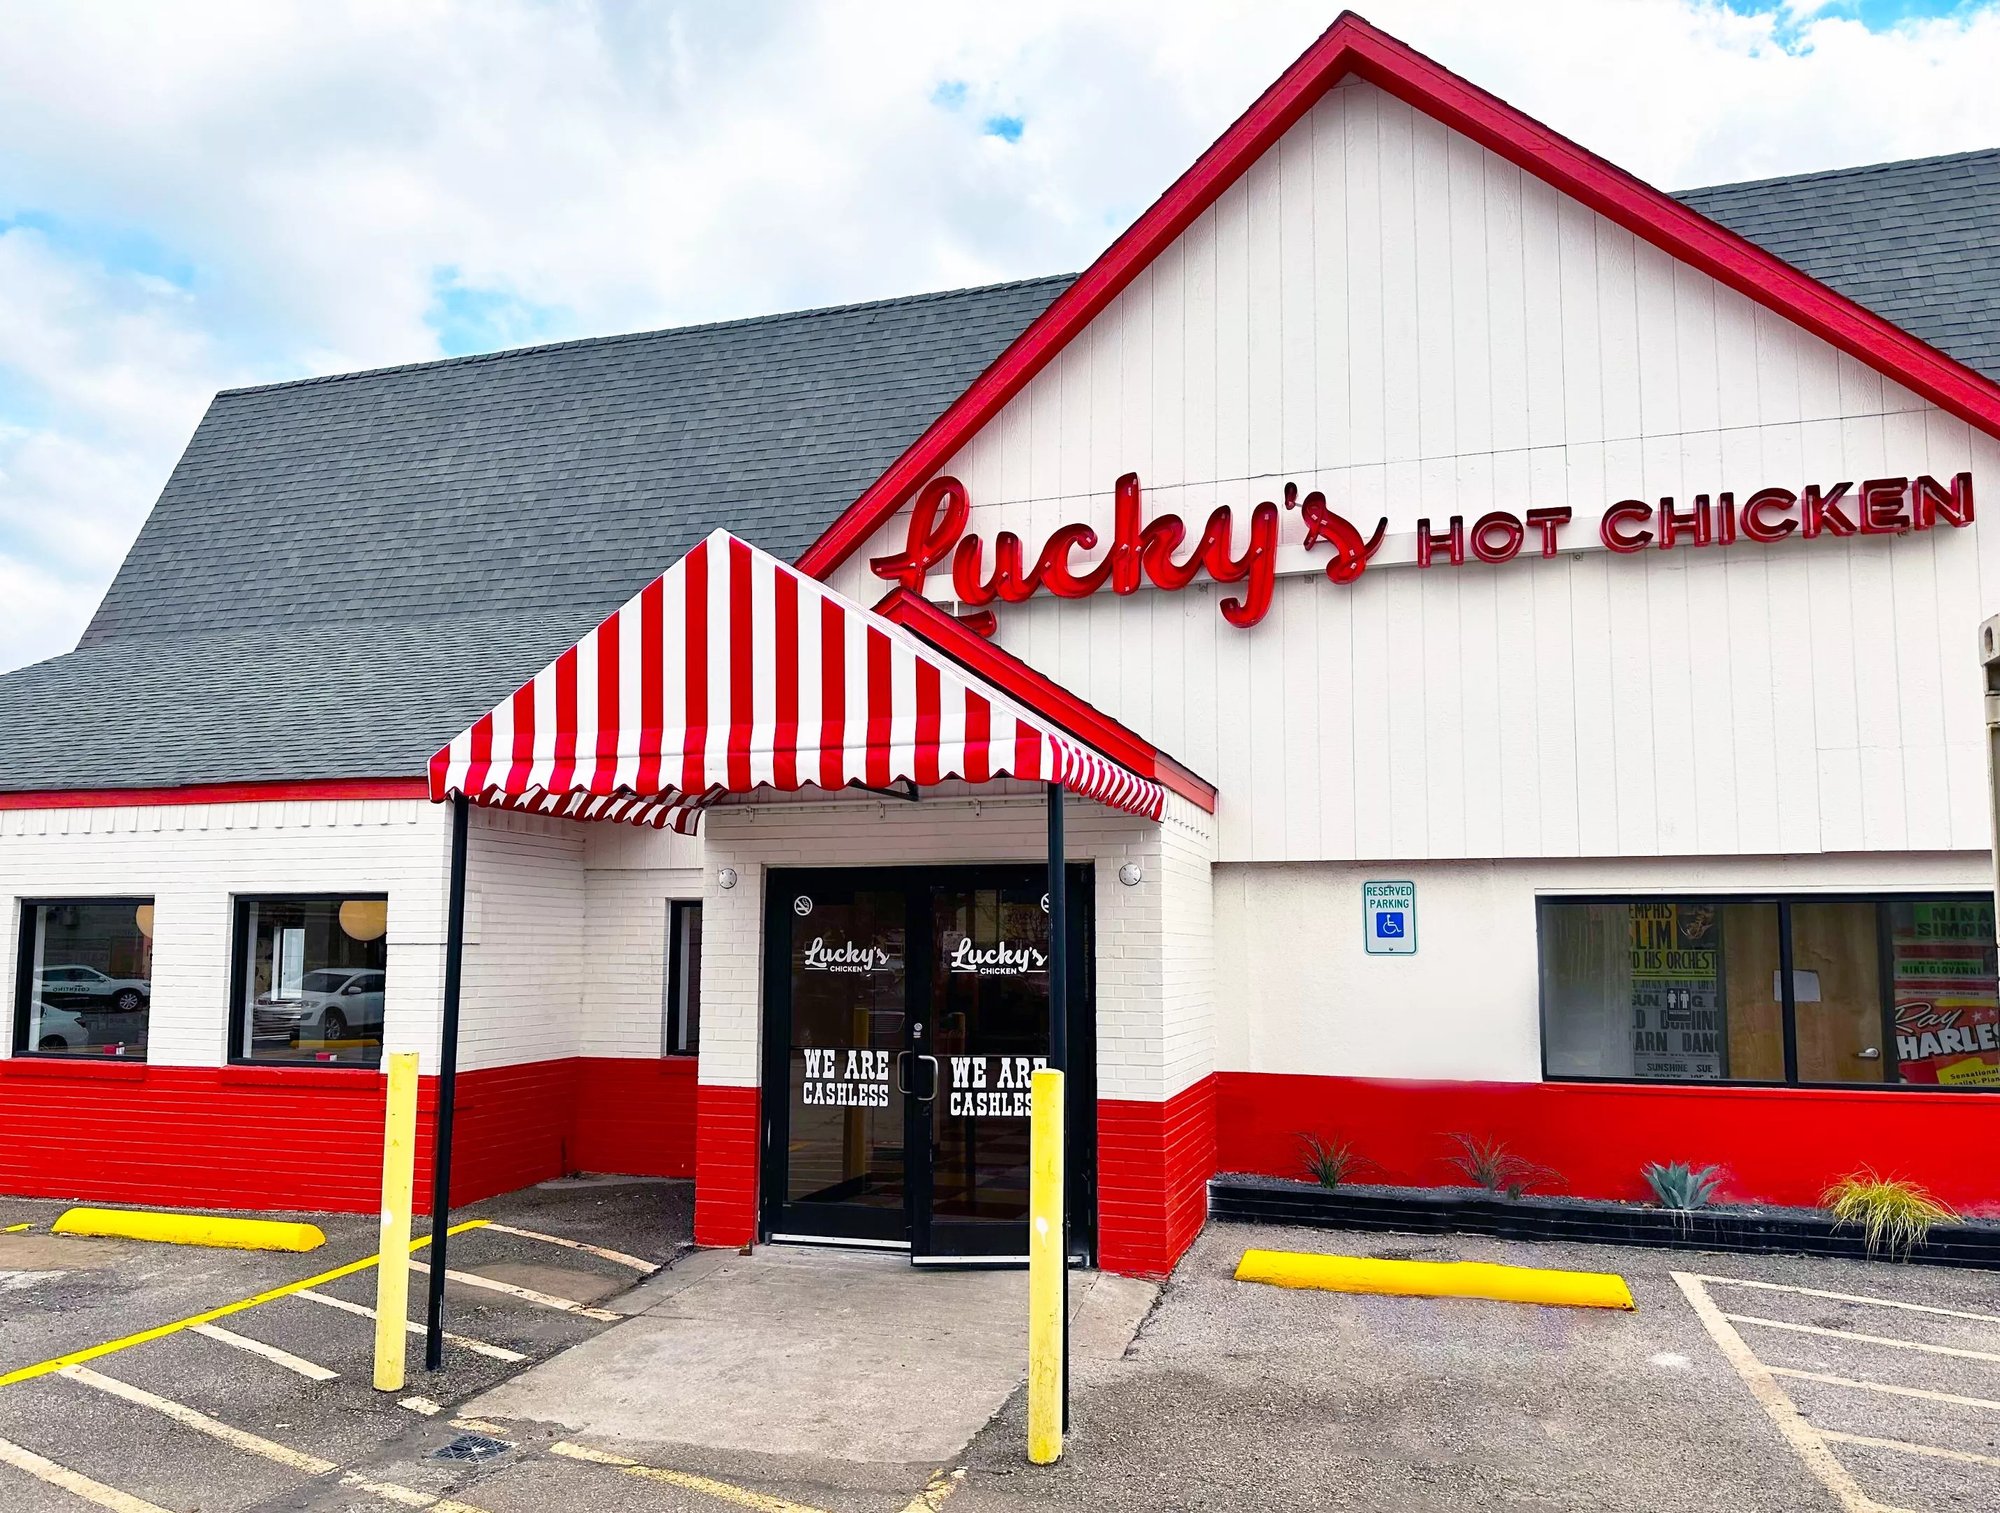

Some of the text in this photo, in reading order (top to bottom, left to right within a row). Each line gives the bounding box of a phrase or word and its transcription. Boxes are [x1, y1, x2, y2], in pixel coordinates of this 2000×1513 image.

[869, 472, 1974, 637] Lucky's HOT CHICKEN
[1366, 886, 1412, 896] RESERVED
[1370, 899, 1410, 909] PARKING
[1932, 907, 1991, 921] NINA
[1630, 920, 1673, 950] LIM
[804, 937, 890, 971] Lucky's
[951, 937, 1048, 973] Lucky's
[1644, 952, 1662, 969] HIS
[829, 965, 863, 973] CHICKEN
[980, 967, 1017, 975] CHICKEN
[1902, 965, 1982, 975] NIKI GIOVANNI
[1895, 1002, 1962, 1033] Ray
[1682, 1033, 1718, 1052] DAN
[803, 1049, 889, 1080] WE ARE
[950, 1057, 987, 1088] WE
[1647, 1062, 1713, 1073] SUNSHINE SUE
[1950, 1067, 1999, 1080] Sensational
[803, 1082, 889, 1107] CASHLESS
[950, 1092, 1032, 1117] CASHLES
